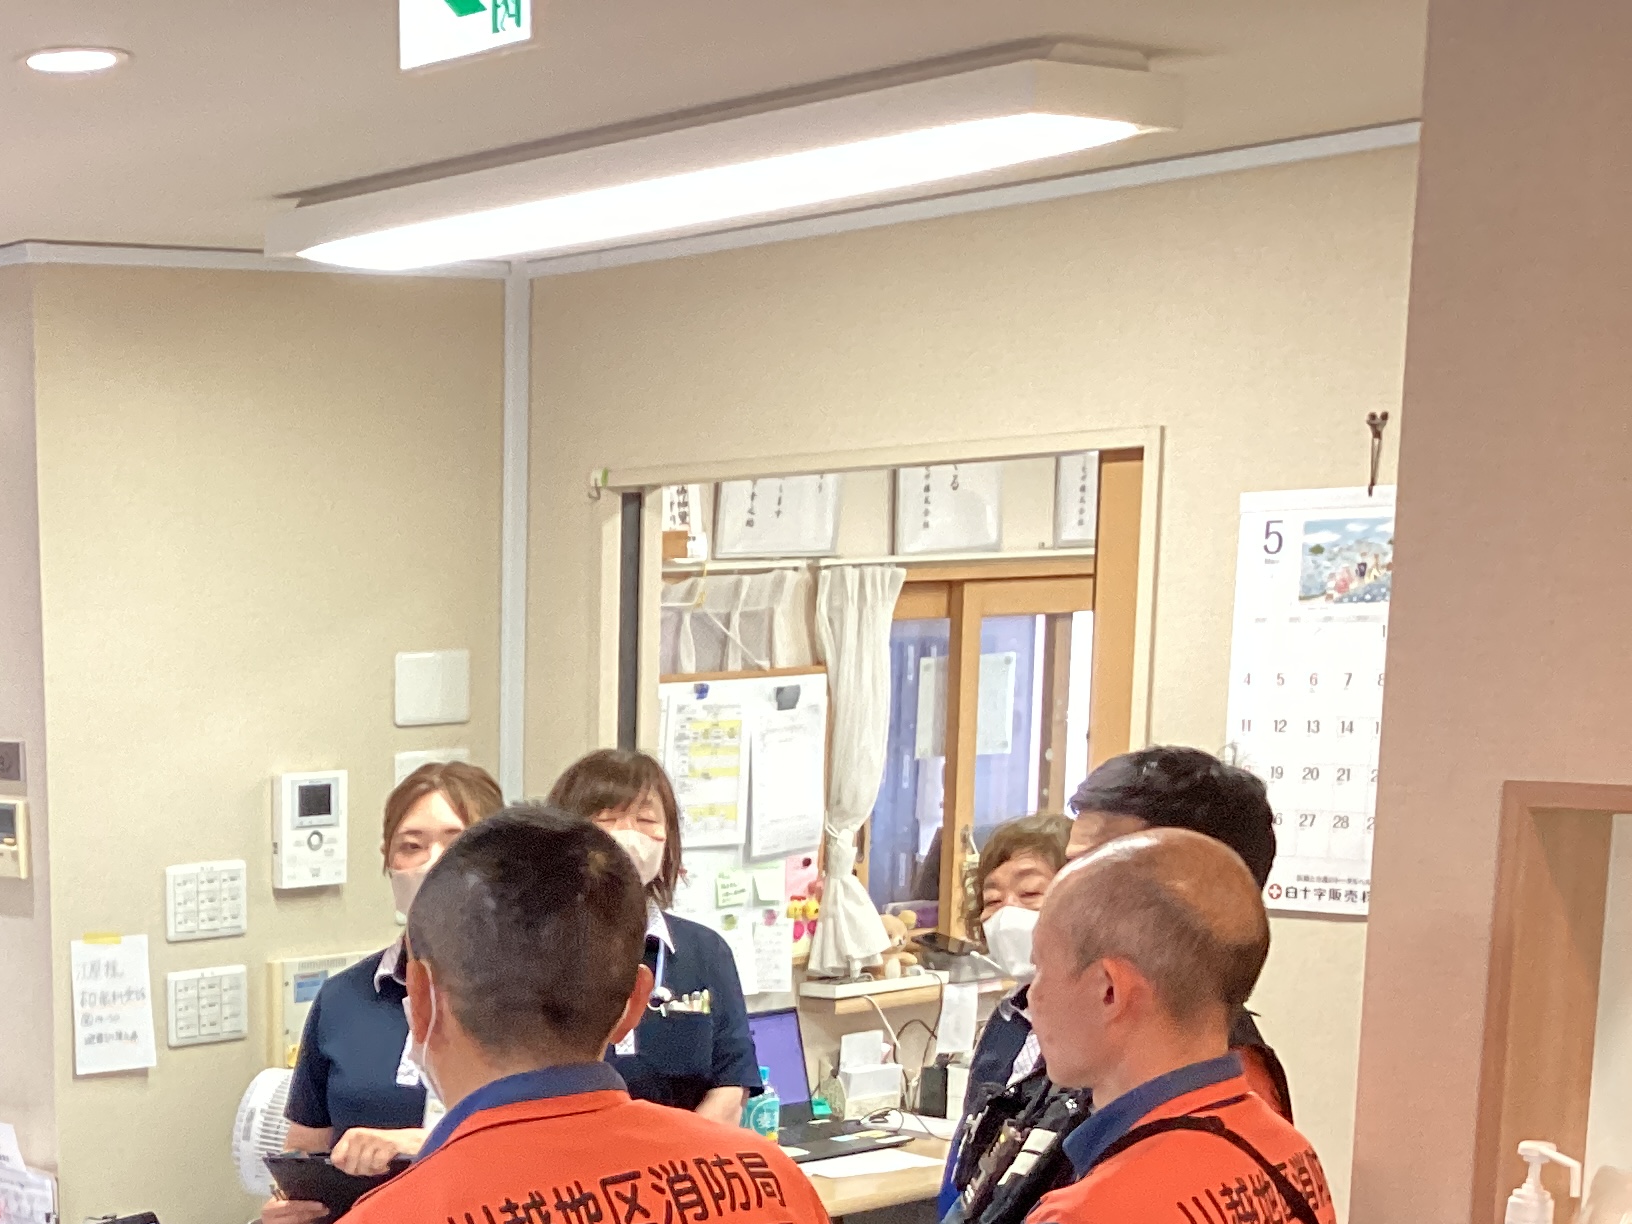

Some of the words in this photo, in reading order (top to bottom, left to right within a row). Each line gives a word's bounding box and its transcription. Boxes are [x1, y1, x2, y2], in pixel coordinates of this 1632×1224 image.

[1263, 520, 1284, 555] 5
[1243, 673, 1251, 686] 4
[1277, 672, 1285, 687] 5
[1309, 672, 1318, 687] 6
[1344, 672, 1353, 687] 7
[1241, 719, 1252, 733] 11
[1274, 719, 1288, 733] 12
[1307, 720, 1320, 734] 13
[1341, 720, 1354, 734] 14
[1270, 766, 1284, 780] 19
[1302, 766, 1319, 781] 20
[1336, 768, 1351, 782] 21
[1298, 813, 1316, 828] 27
[1332, 815, 1350, 829] 28
